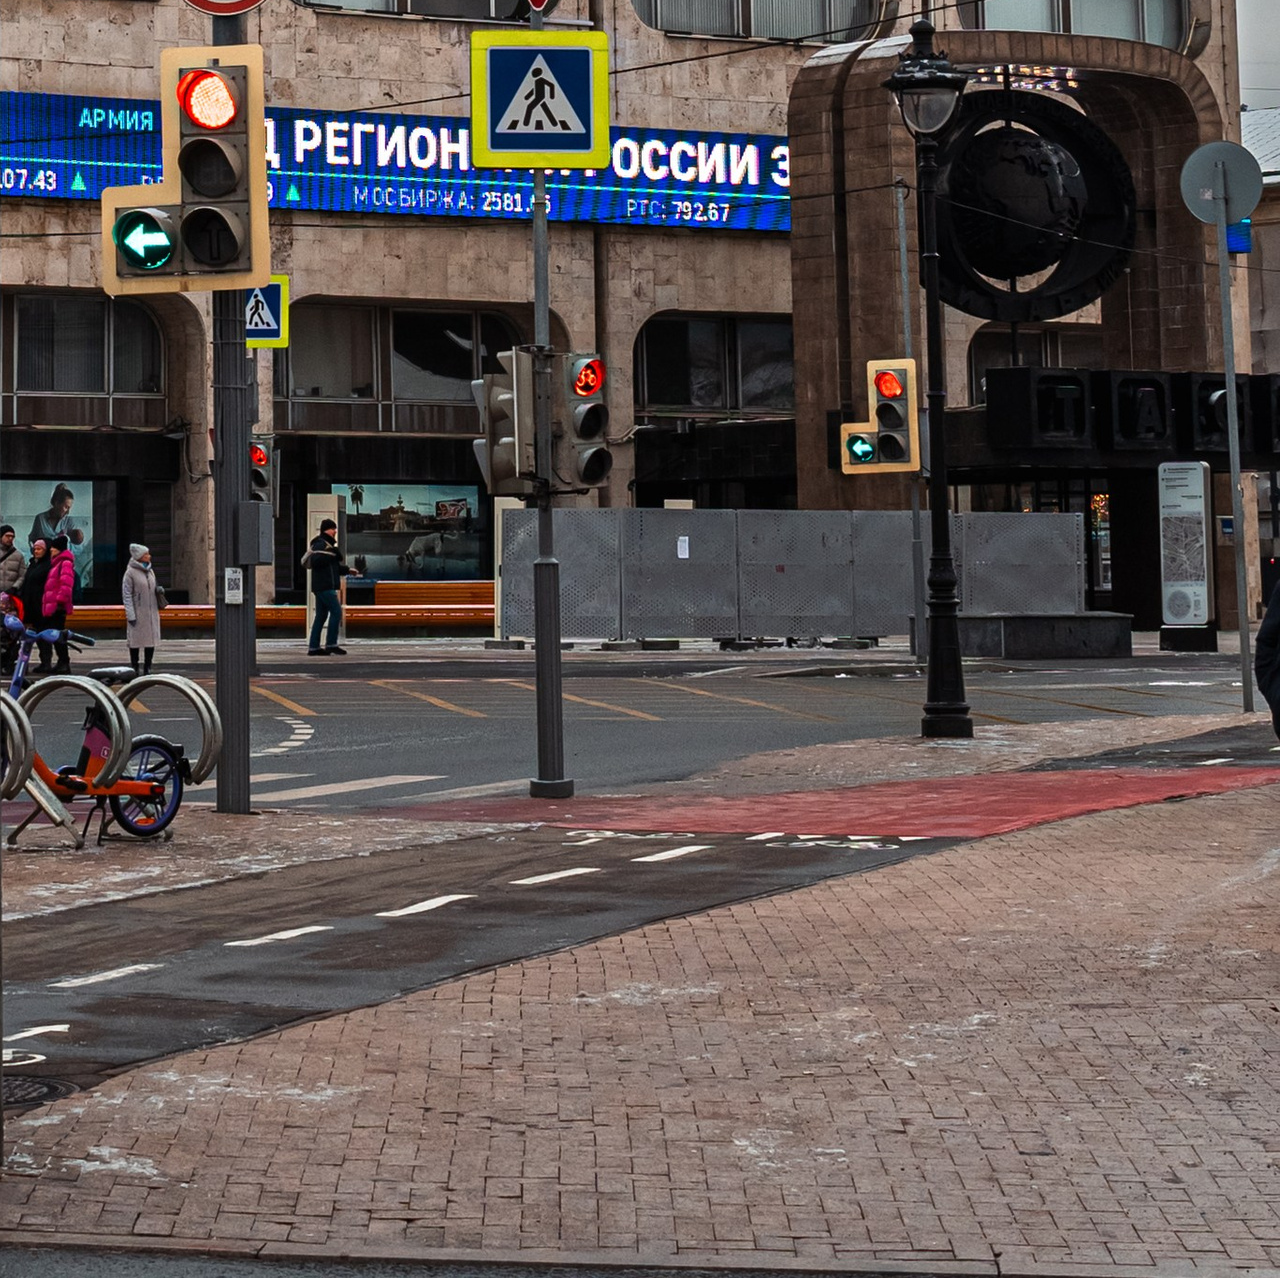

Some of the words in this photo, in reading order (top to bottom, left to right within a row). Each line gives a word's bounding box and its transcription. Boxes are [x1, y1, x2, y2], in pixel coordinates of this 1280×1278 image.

[79, 107, 153, 131] АРМИЯ
[584, 137, 760, 186] ОССИИ
[672, 201, 731, 222] 792.67
